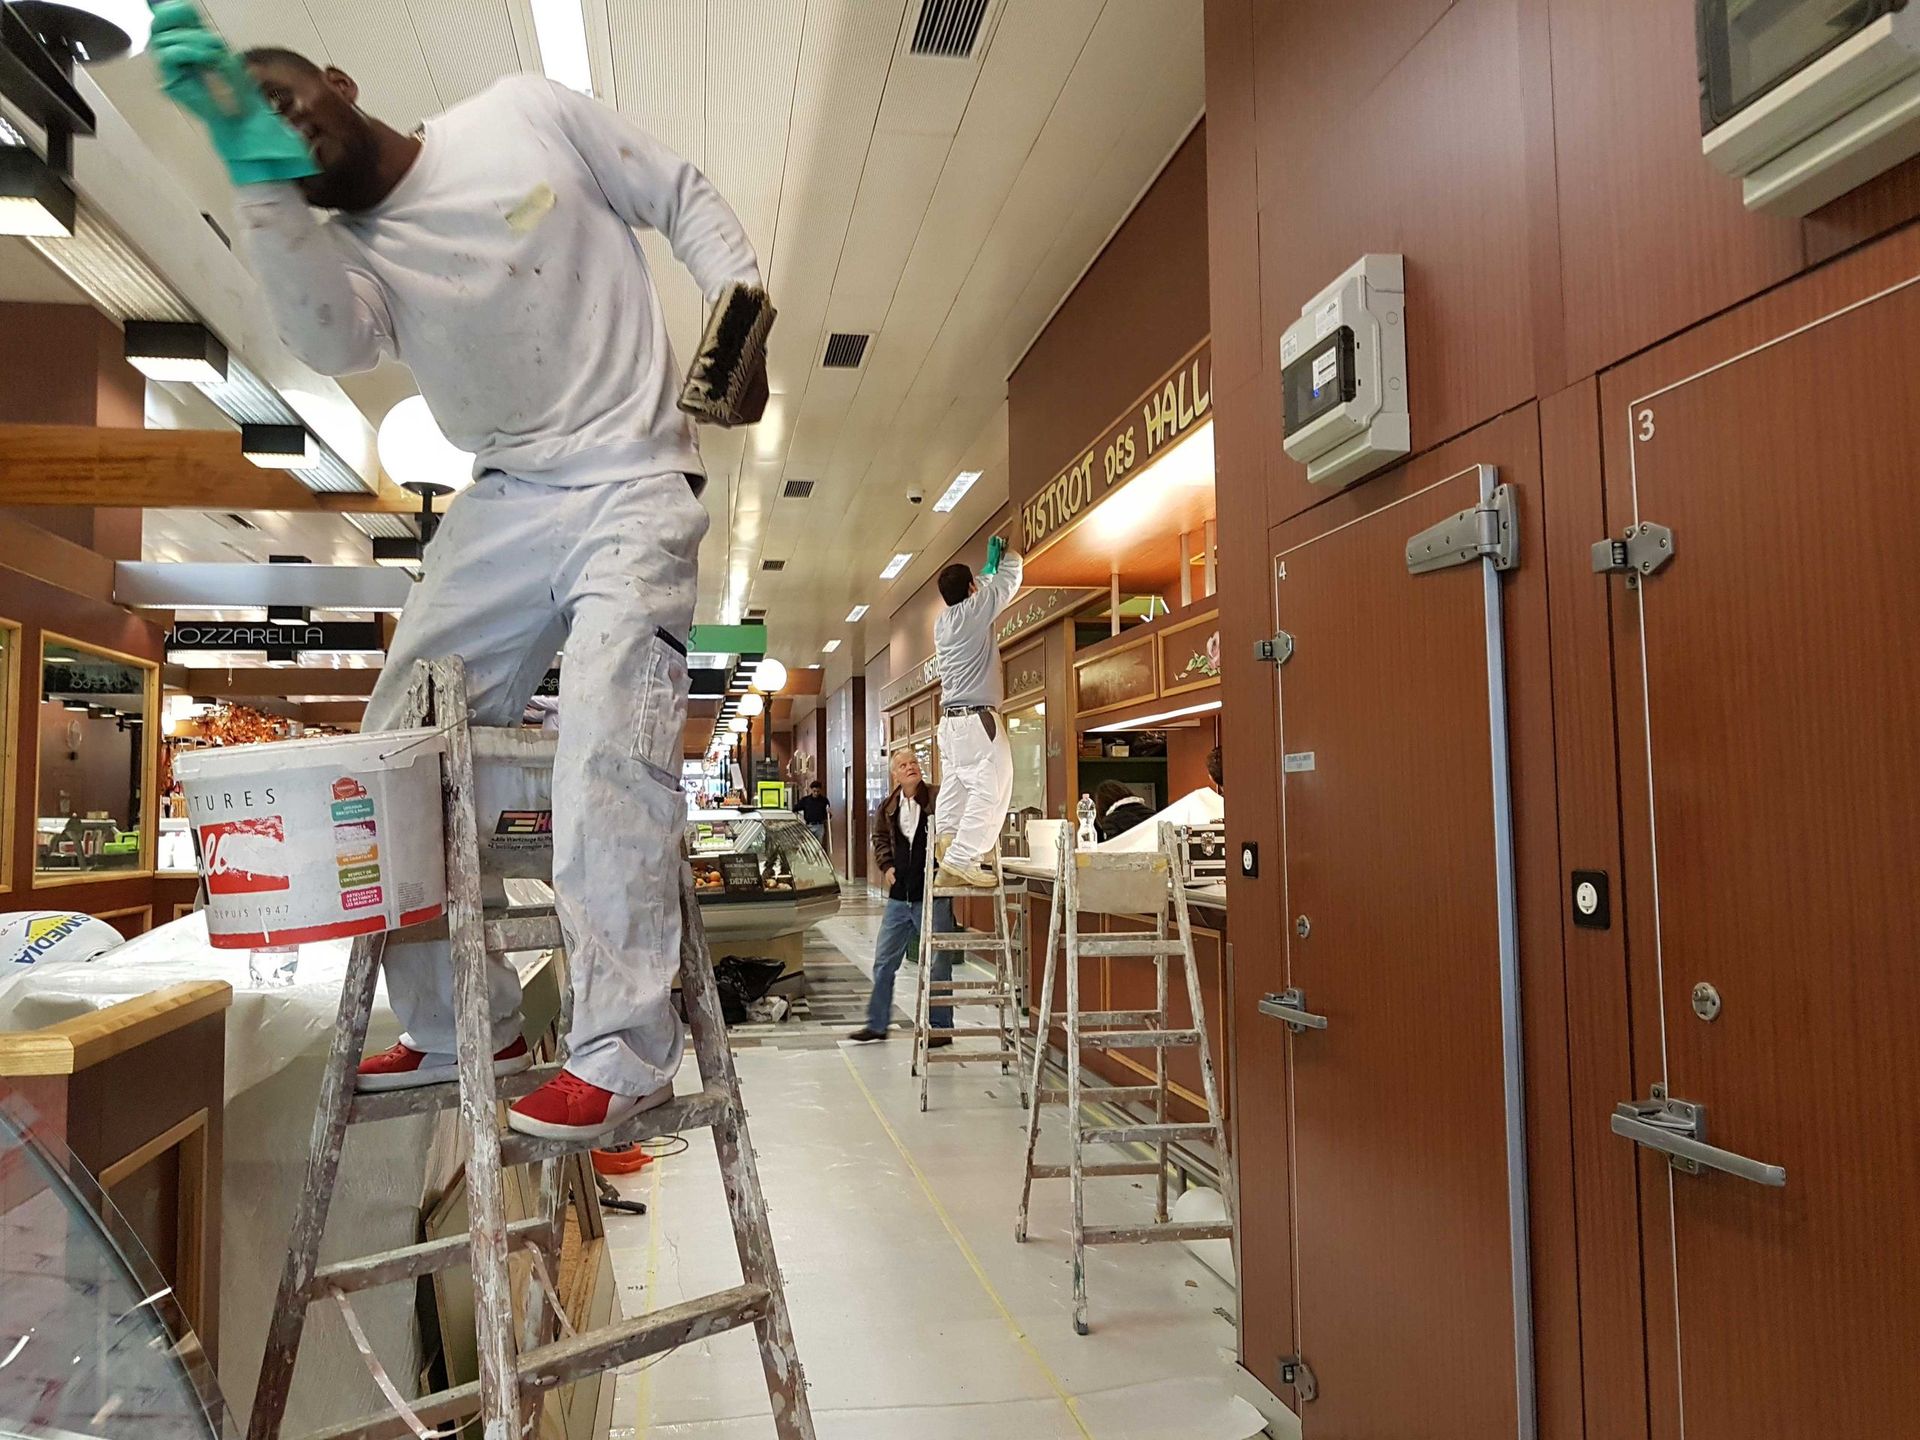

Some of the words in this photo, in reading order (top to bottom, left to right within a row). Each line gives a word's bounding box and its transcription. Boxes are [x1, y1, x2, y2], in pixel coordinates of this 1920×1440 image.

[1638, 409, 1655, 442] 3
[1023, 450, 1095, 553] BISTROT
[1104, 426, 1135, 485] DES
[1143, 358, 1214, 455] HALL
[1279, 561, 1287, 580] 4
[214, 908, 249, 920] DEPUIS
[258, 904, 289, 917] 1947
